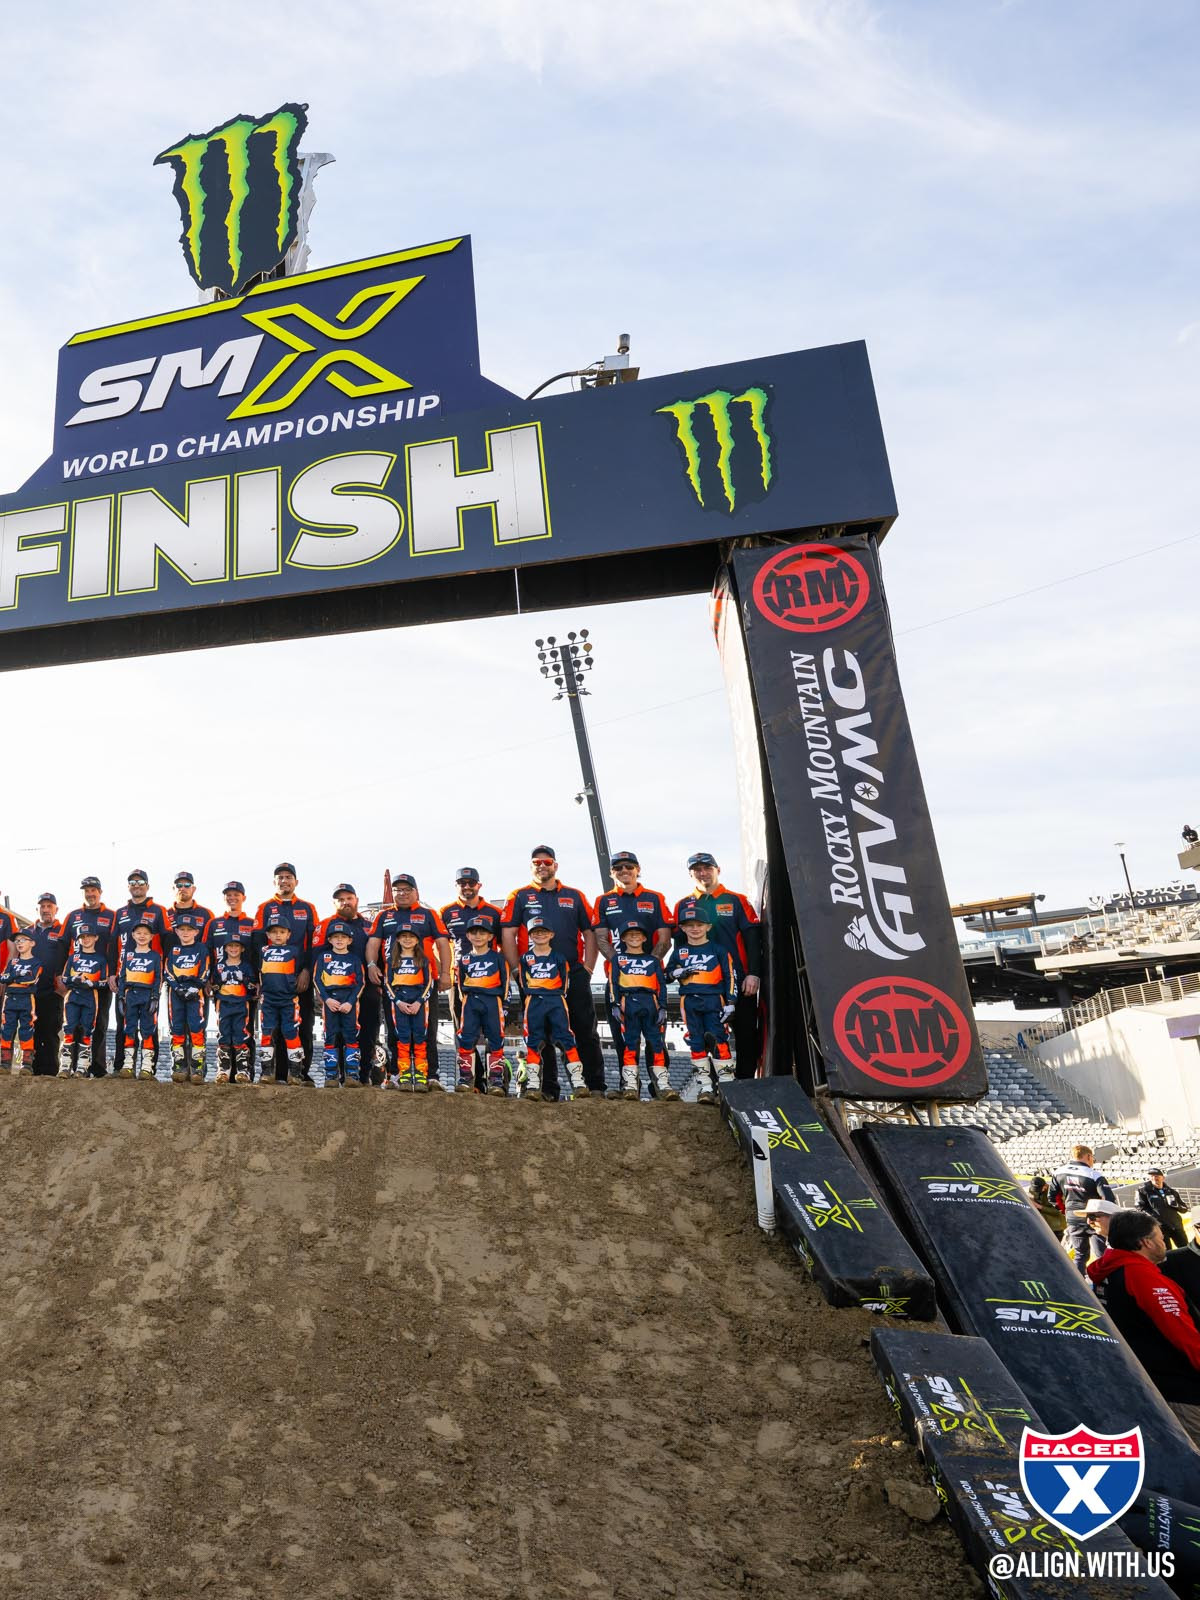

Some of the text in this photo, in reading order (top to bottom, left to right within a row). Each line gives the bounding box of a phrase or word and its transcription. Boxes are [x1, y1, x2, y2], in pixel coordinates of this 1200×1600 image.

[64, 275, 426, 427] SMX
[63, 394, 441, 479] WORLD CHAMPIONSHIP
[775, 562, 853, 610] RM
[790, 650, 864, 910] ROCKY MOUNTAIN
[1120, 894, 1183, 907] TEQUILA
[176, 953, 200, 963] FLY
[264, 948, 291, 957] FLY
[684, 954, 715, 967] FLY
[129, 958, 153, 967] FLY
[327, 960, 353, 970] FLY
[468, 961, 495, 972] FLY
[530, 963, 557, 974] FLY
[859, 1007, 946, 1054] RM
[927, 1180, 1023, 1203] SMX
[798, 1181, 854, 1231] SMX
[964, 1198, 1031, 1209] CHAMPIONSHIP
[995, 1306, 1110, 1337] SMX
[1001, 1326, 1120, 1344] WORLD CHAMPIONSHIP
[1157, 1496, 1173, 1550] MONSTER
